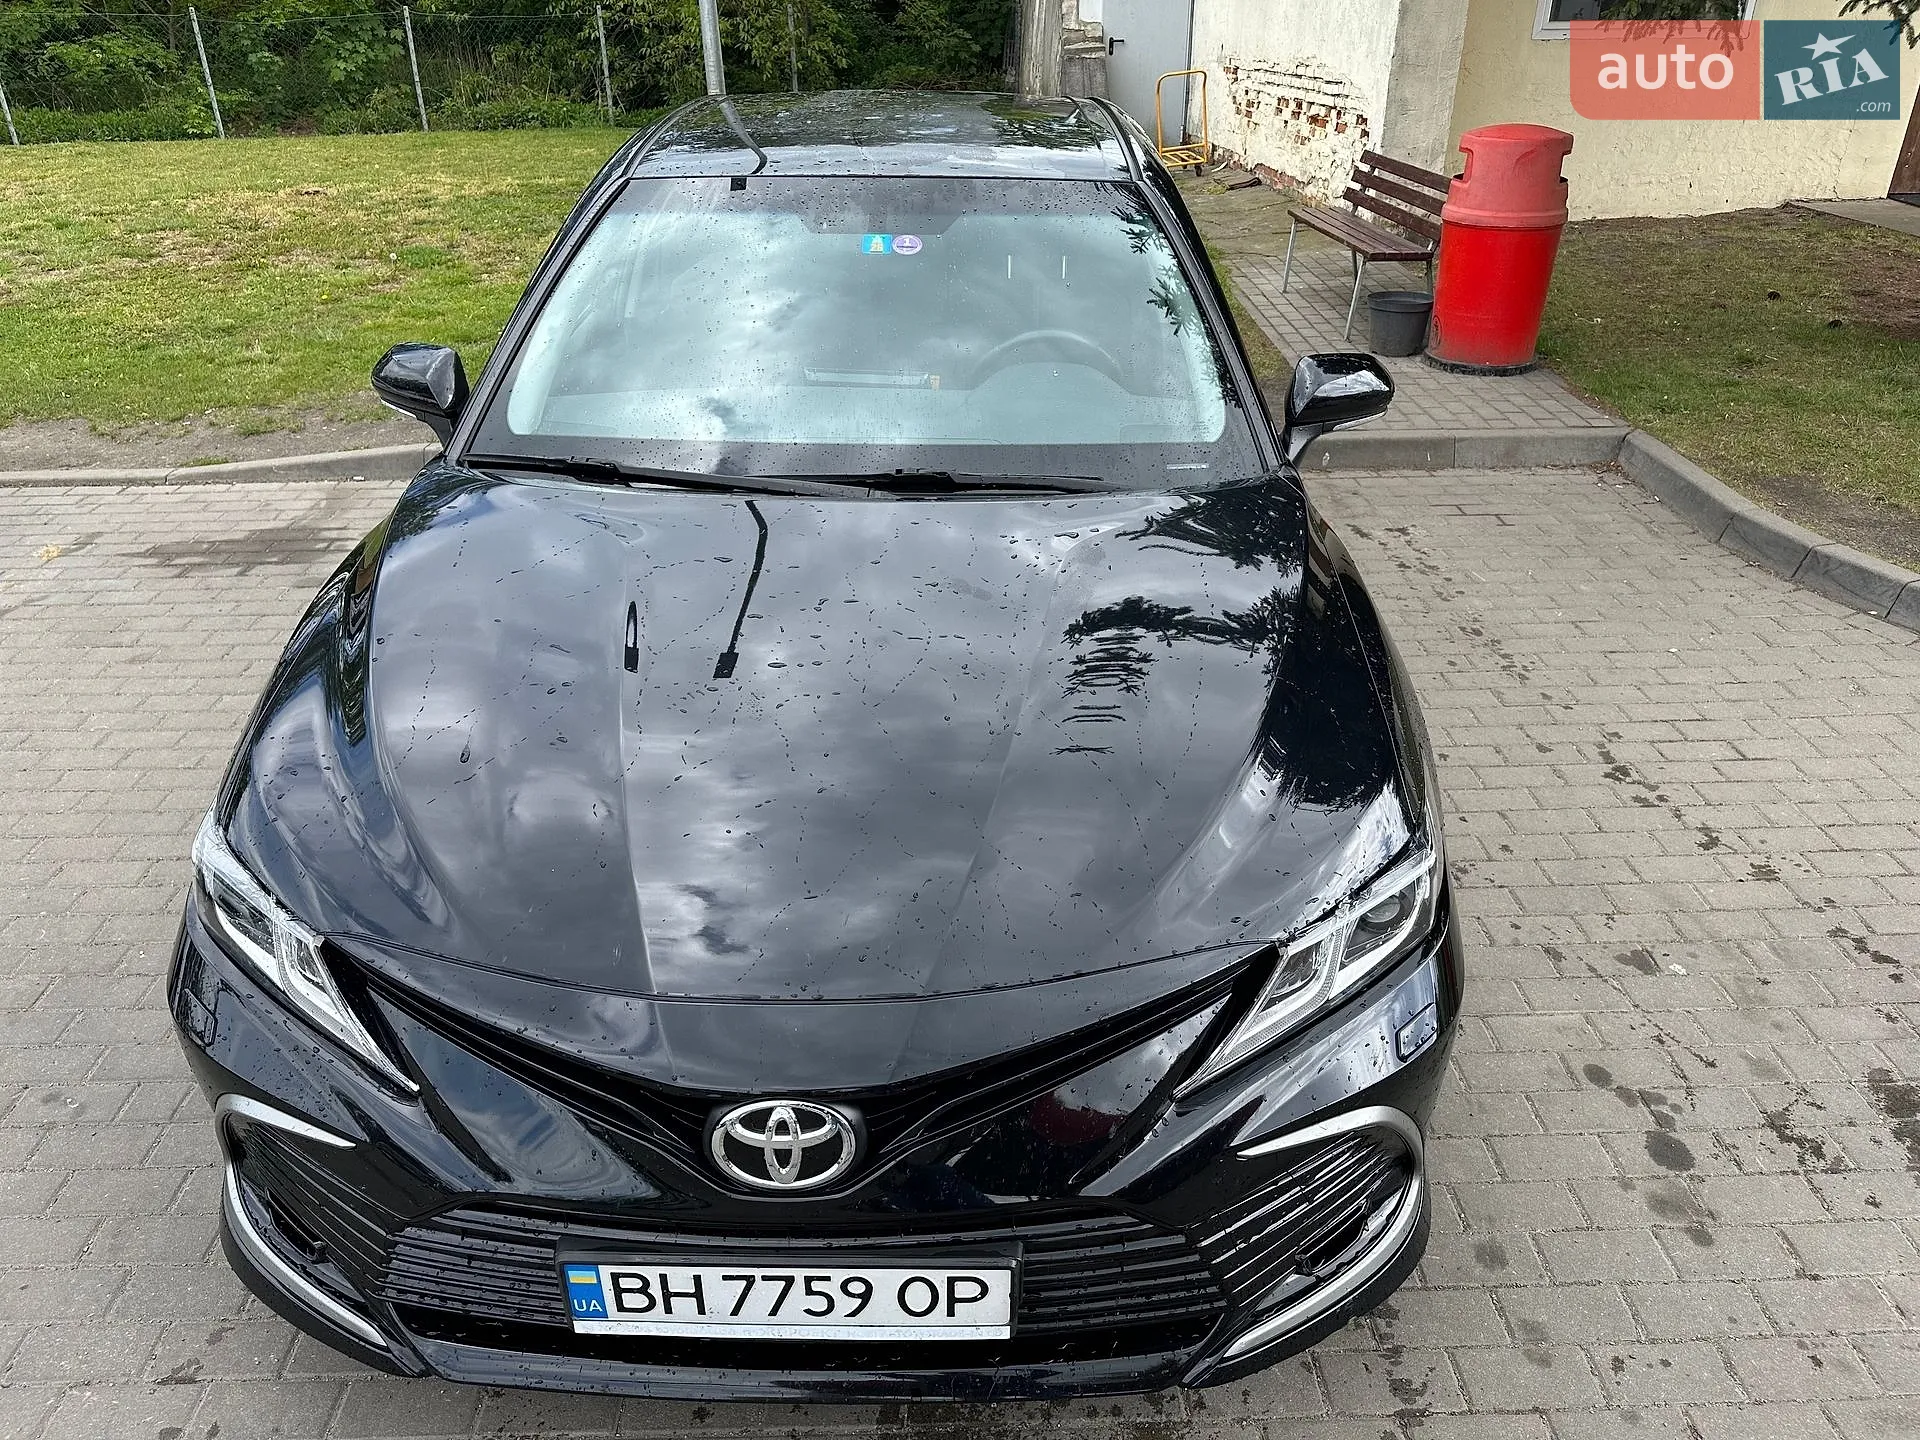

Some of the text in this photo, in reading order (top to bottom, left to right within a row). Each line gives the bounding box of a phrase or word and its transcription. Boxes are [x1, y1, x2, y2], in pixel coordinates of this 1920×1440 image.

[574, 1298, 603, 1313] UA
[610, 1272, 989, 1318] BH 7759 OP
